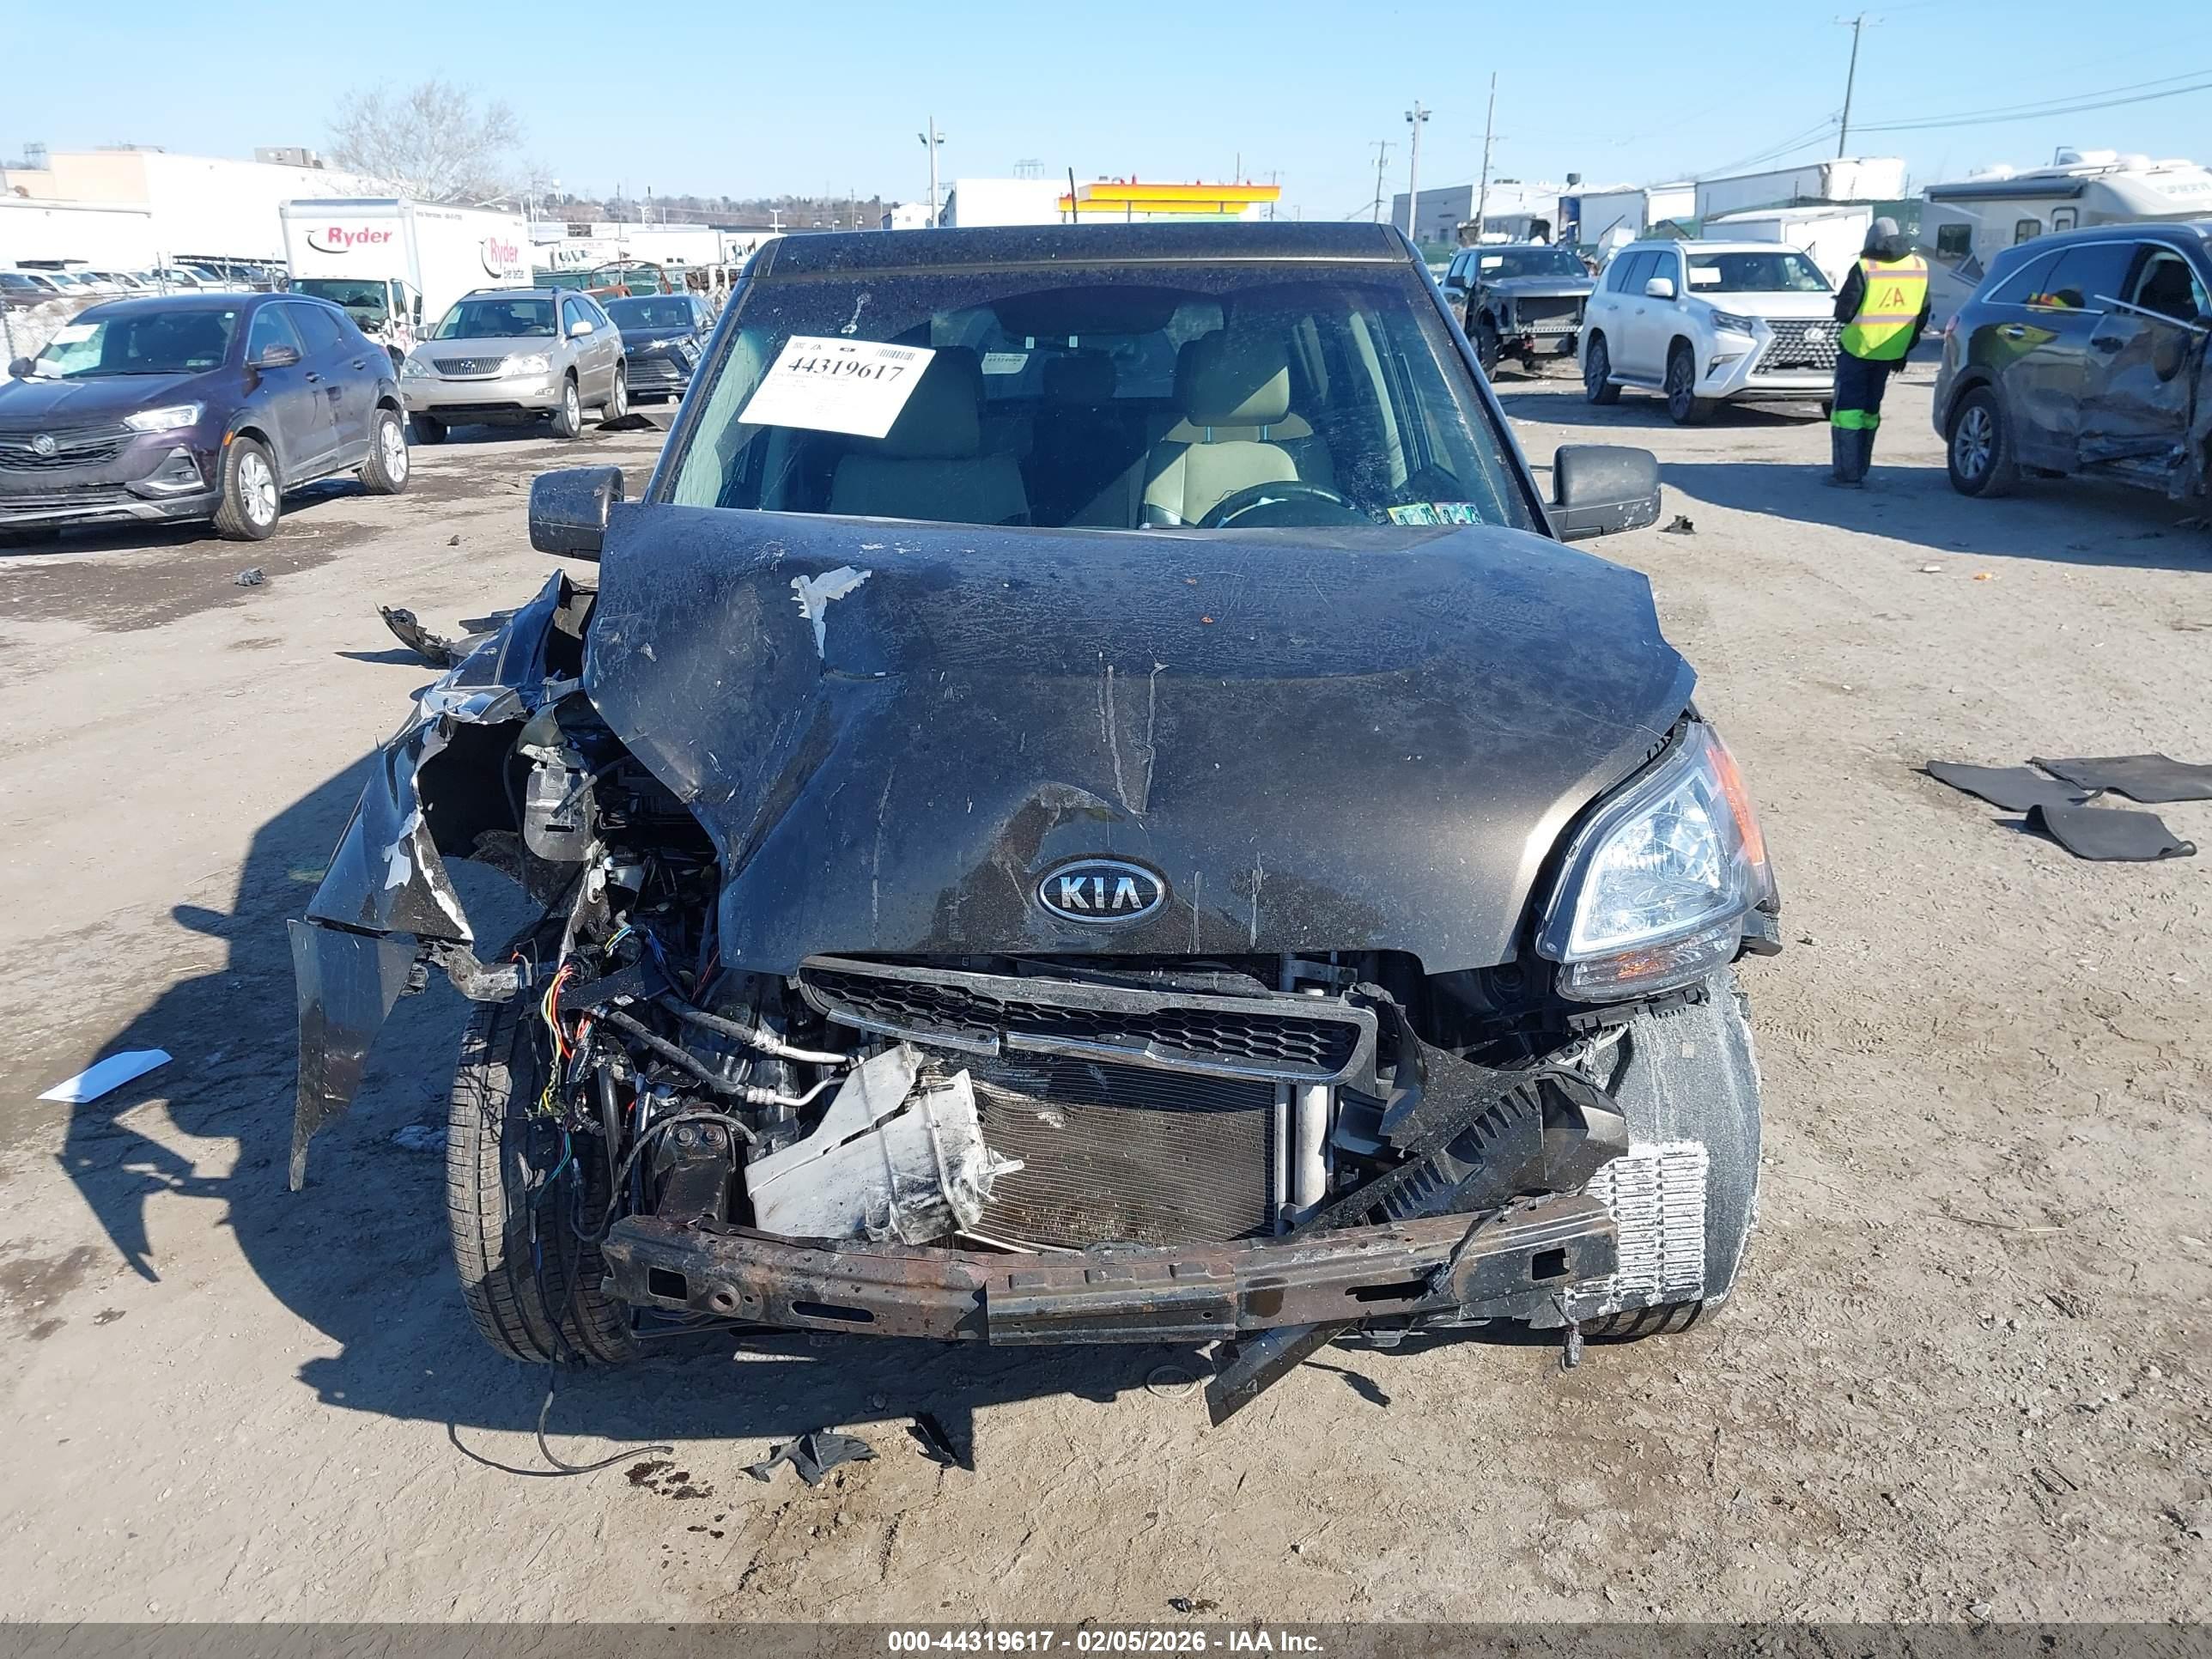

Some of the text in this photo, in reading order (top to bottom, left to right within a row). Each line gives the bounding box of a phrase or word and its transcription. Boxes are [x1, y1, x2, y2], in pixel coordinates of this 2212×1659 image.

[327, 227, 392, 247] Ryder
[489, 237, 520, 269] Ryder
[787, 356, 908, 382] 44319617
[1059, 876, 1144, 909] KIA
